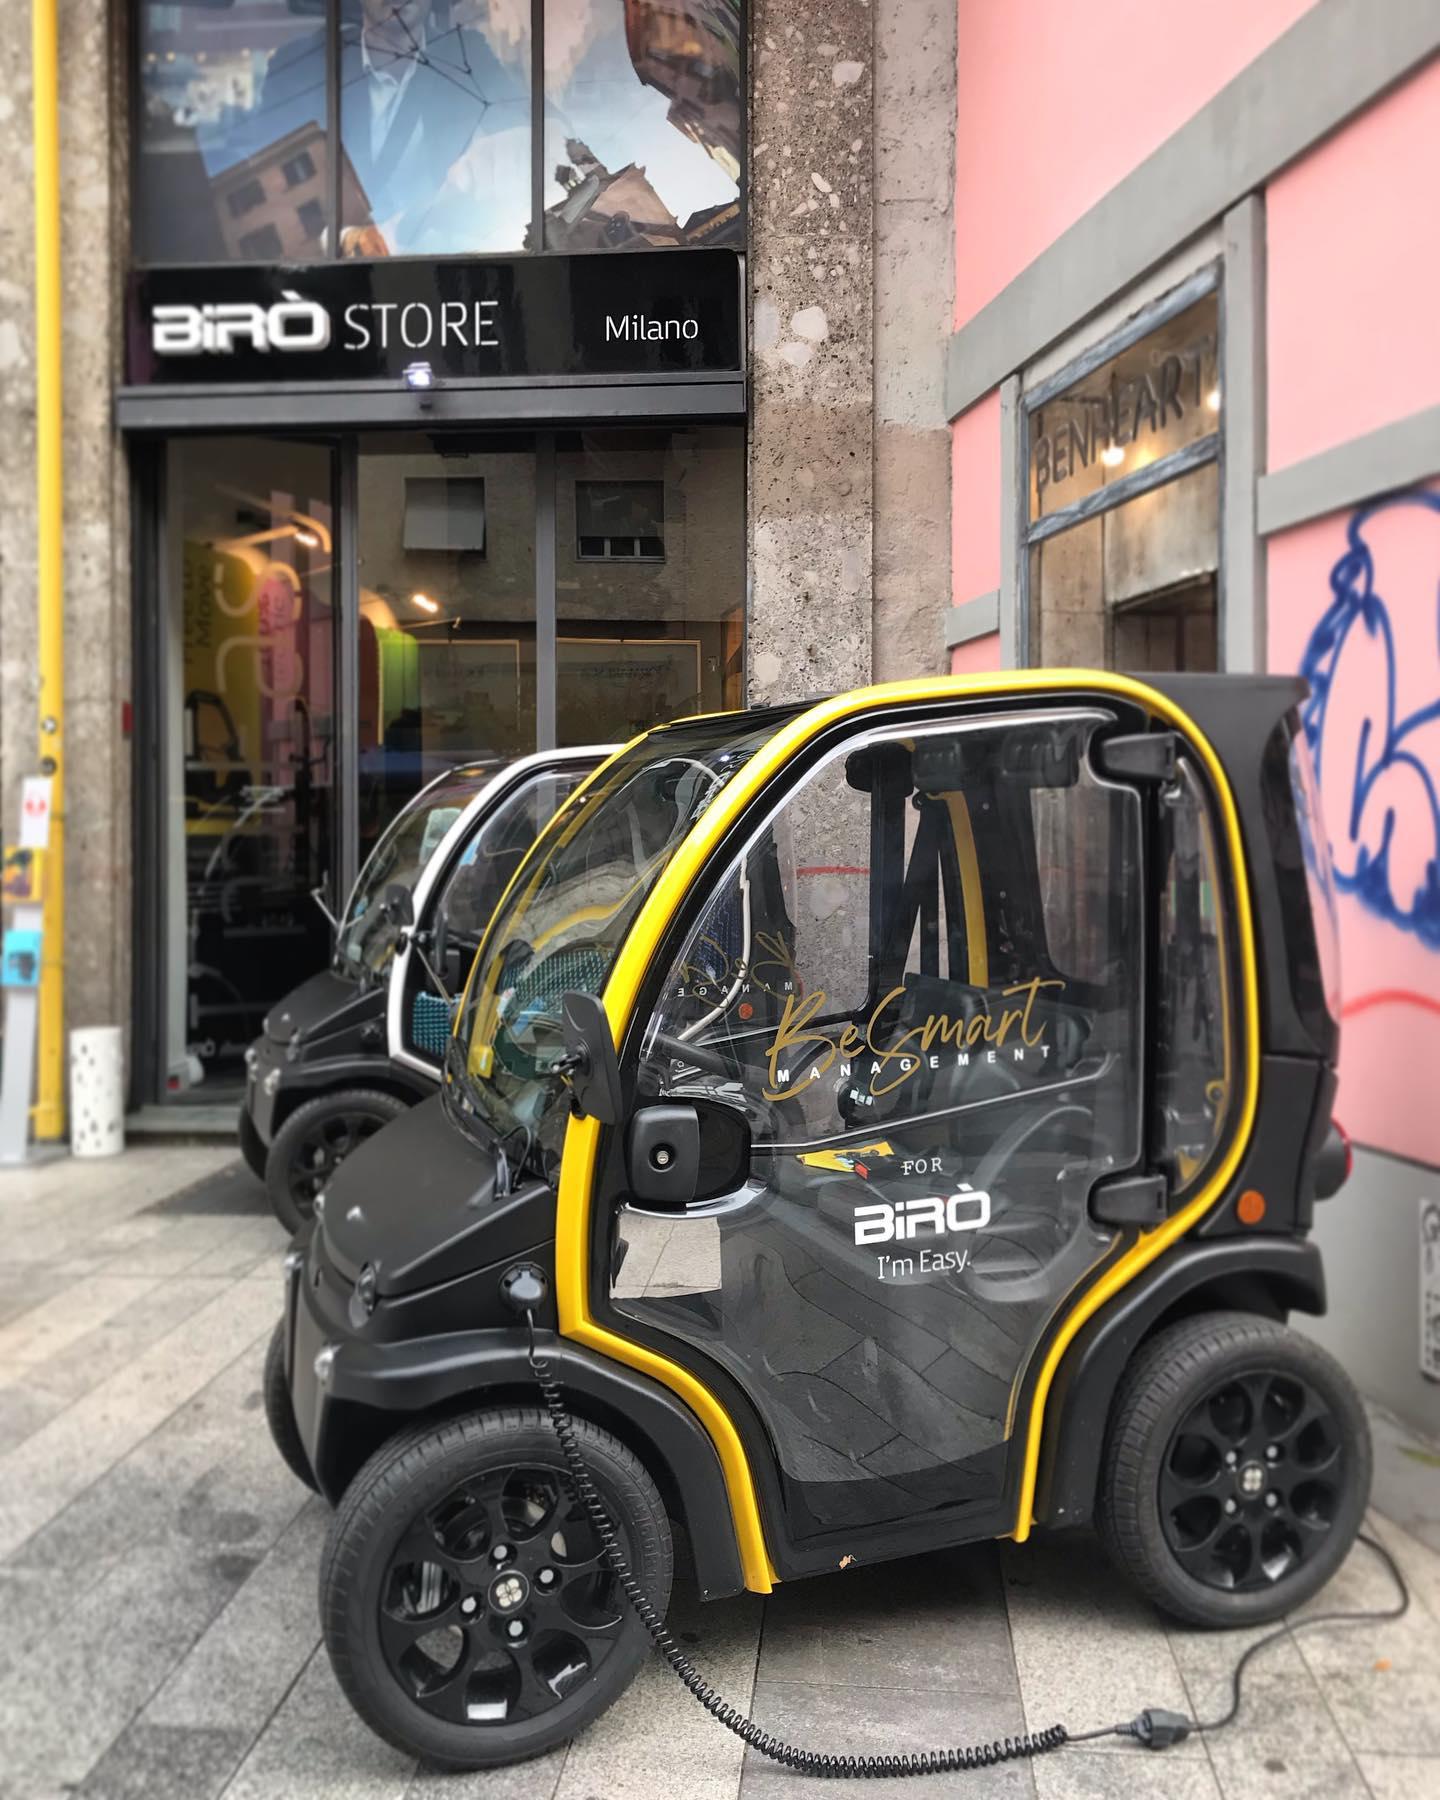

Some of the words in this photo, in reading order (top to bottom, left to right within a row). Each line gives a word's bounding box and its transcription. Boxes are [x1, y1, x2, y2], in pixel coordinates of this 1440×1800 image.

[345, 301, 498, 349] STORE
[606, 315, 698, 341] Milano
[777, 1046, 1050, 1082] MANAGEMENT
[901, 1158, 942, 1175] FOR
[918, 1249, 975, 1278] Easy.
